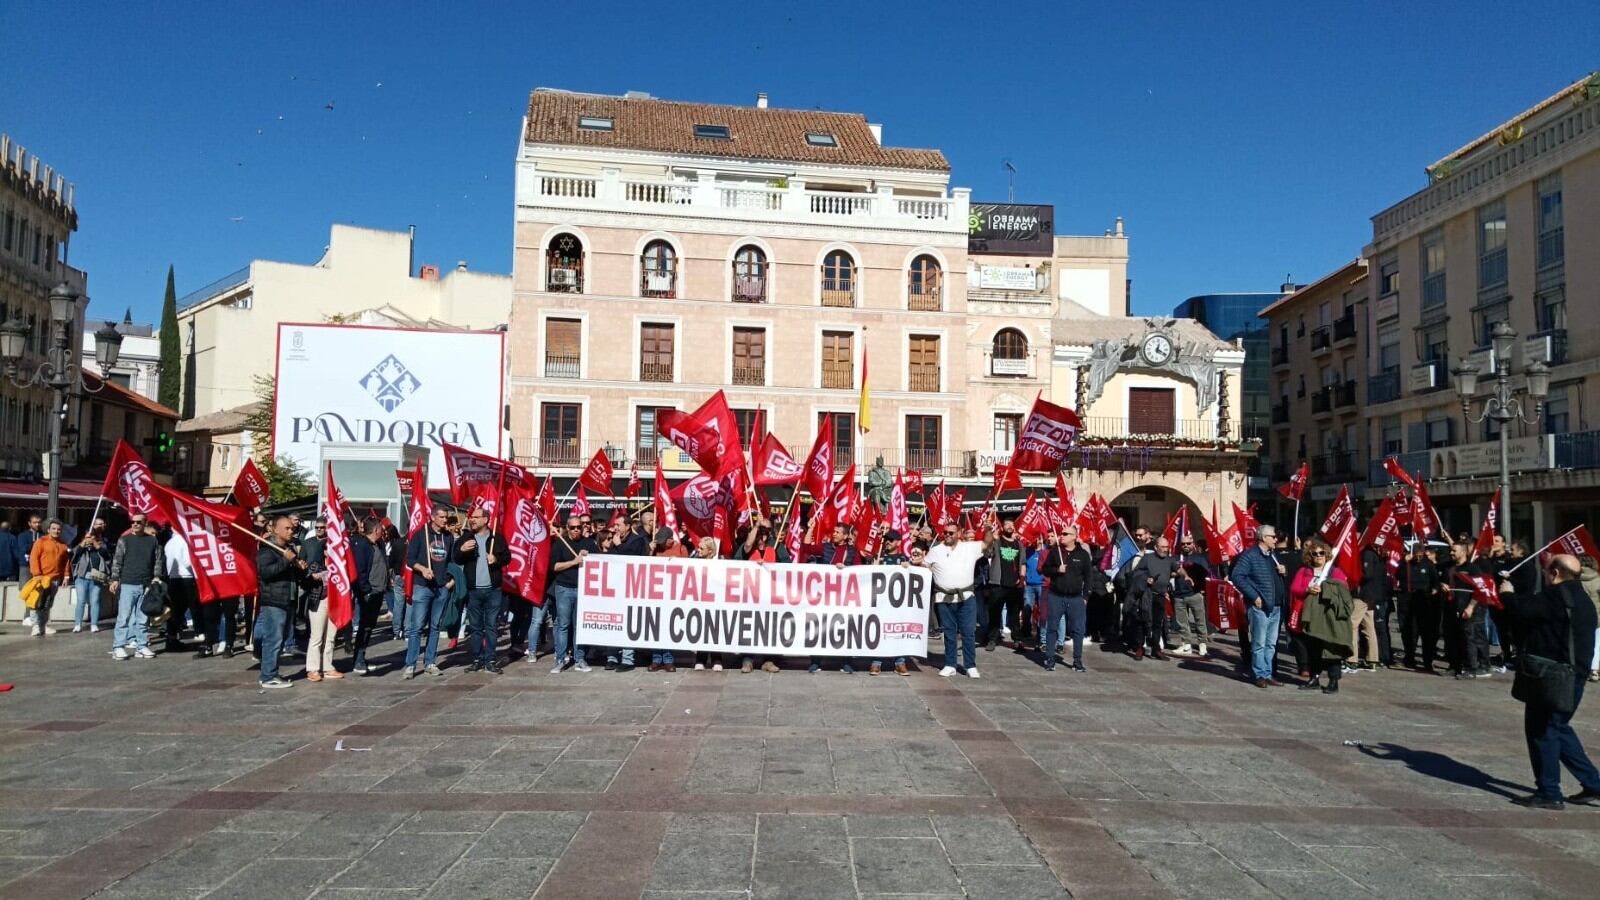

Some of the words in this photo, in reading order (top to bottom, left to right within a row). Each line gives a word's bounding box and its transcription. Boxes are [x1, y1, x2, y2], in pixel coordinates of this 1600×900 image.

[993, 214, 1038, 224] OBRAMA
[993, 222, 1034, 231] ENERGY
[291, 412, 482, 448] PANDORGA
[1047, 446, 1063, 460] Rea
[326, 564, 349, 597] Real
[583, 560, 616, 598] EL
[625, 562, 715, 603] METAL
[725, 567, 760, 604] EN
[770, 570, 862, 607] LUCHA
[871, 571, 924, 609] POR
[585, 613, 611, 622] CCOO
[582, 622, 624, 632] industria
[627, 605, 661, 642] UN
[669, 607, 796, 648] CONVENIO
[804, 612, 881, 650] DIGNO
[884, 623, 911, 633] UGT
[901, 633, 922, 641] FICA
